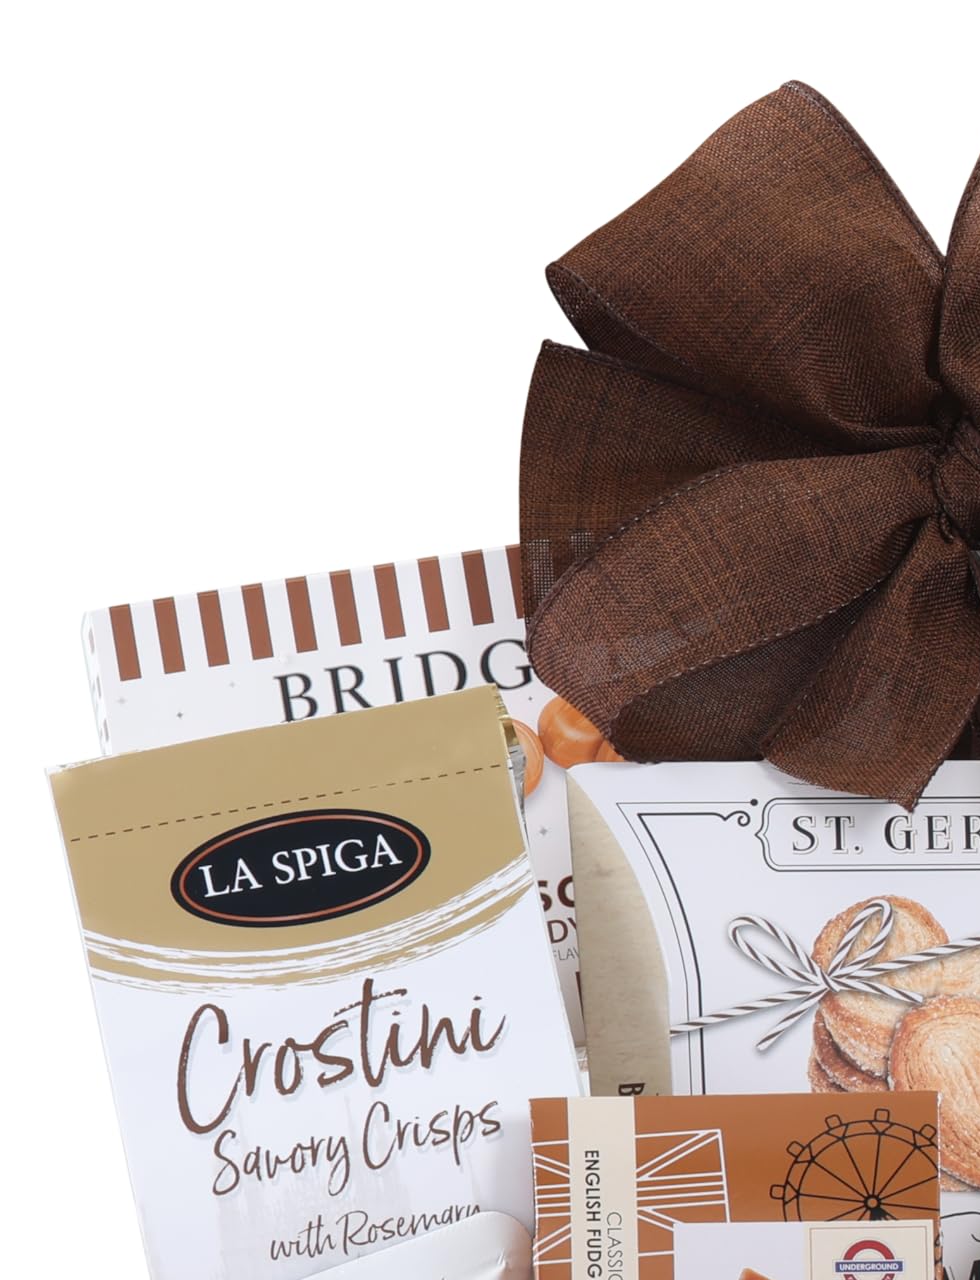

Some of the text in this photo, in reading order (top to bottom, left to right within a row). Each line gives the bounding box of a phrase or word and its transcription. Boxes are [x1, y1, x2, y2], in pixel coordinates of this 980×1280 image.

[198, 834, 403, 898] LA SPIGA
[792, 815, 864, 854] ST.
[177, 978, 506, 1134] Crostini
[212, 1100, 502, 1196] Savory Crisps
[584, 1150, 601, 1222] ENGLISH
[270, 1214, 336, 1261] with
[839, 1262, 899, 1272] UNDERGROUND
